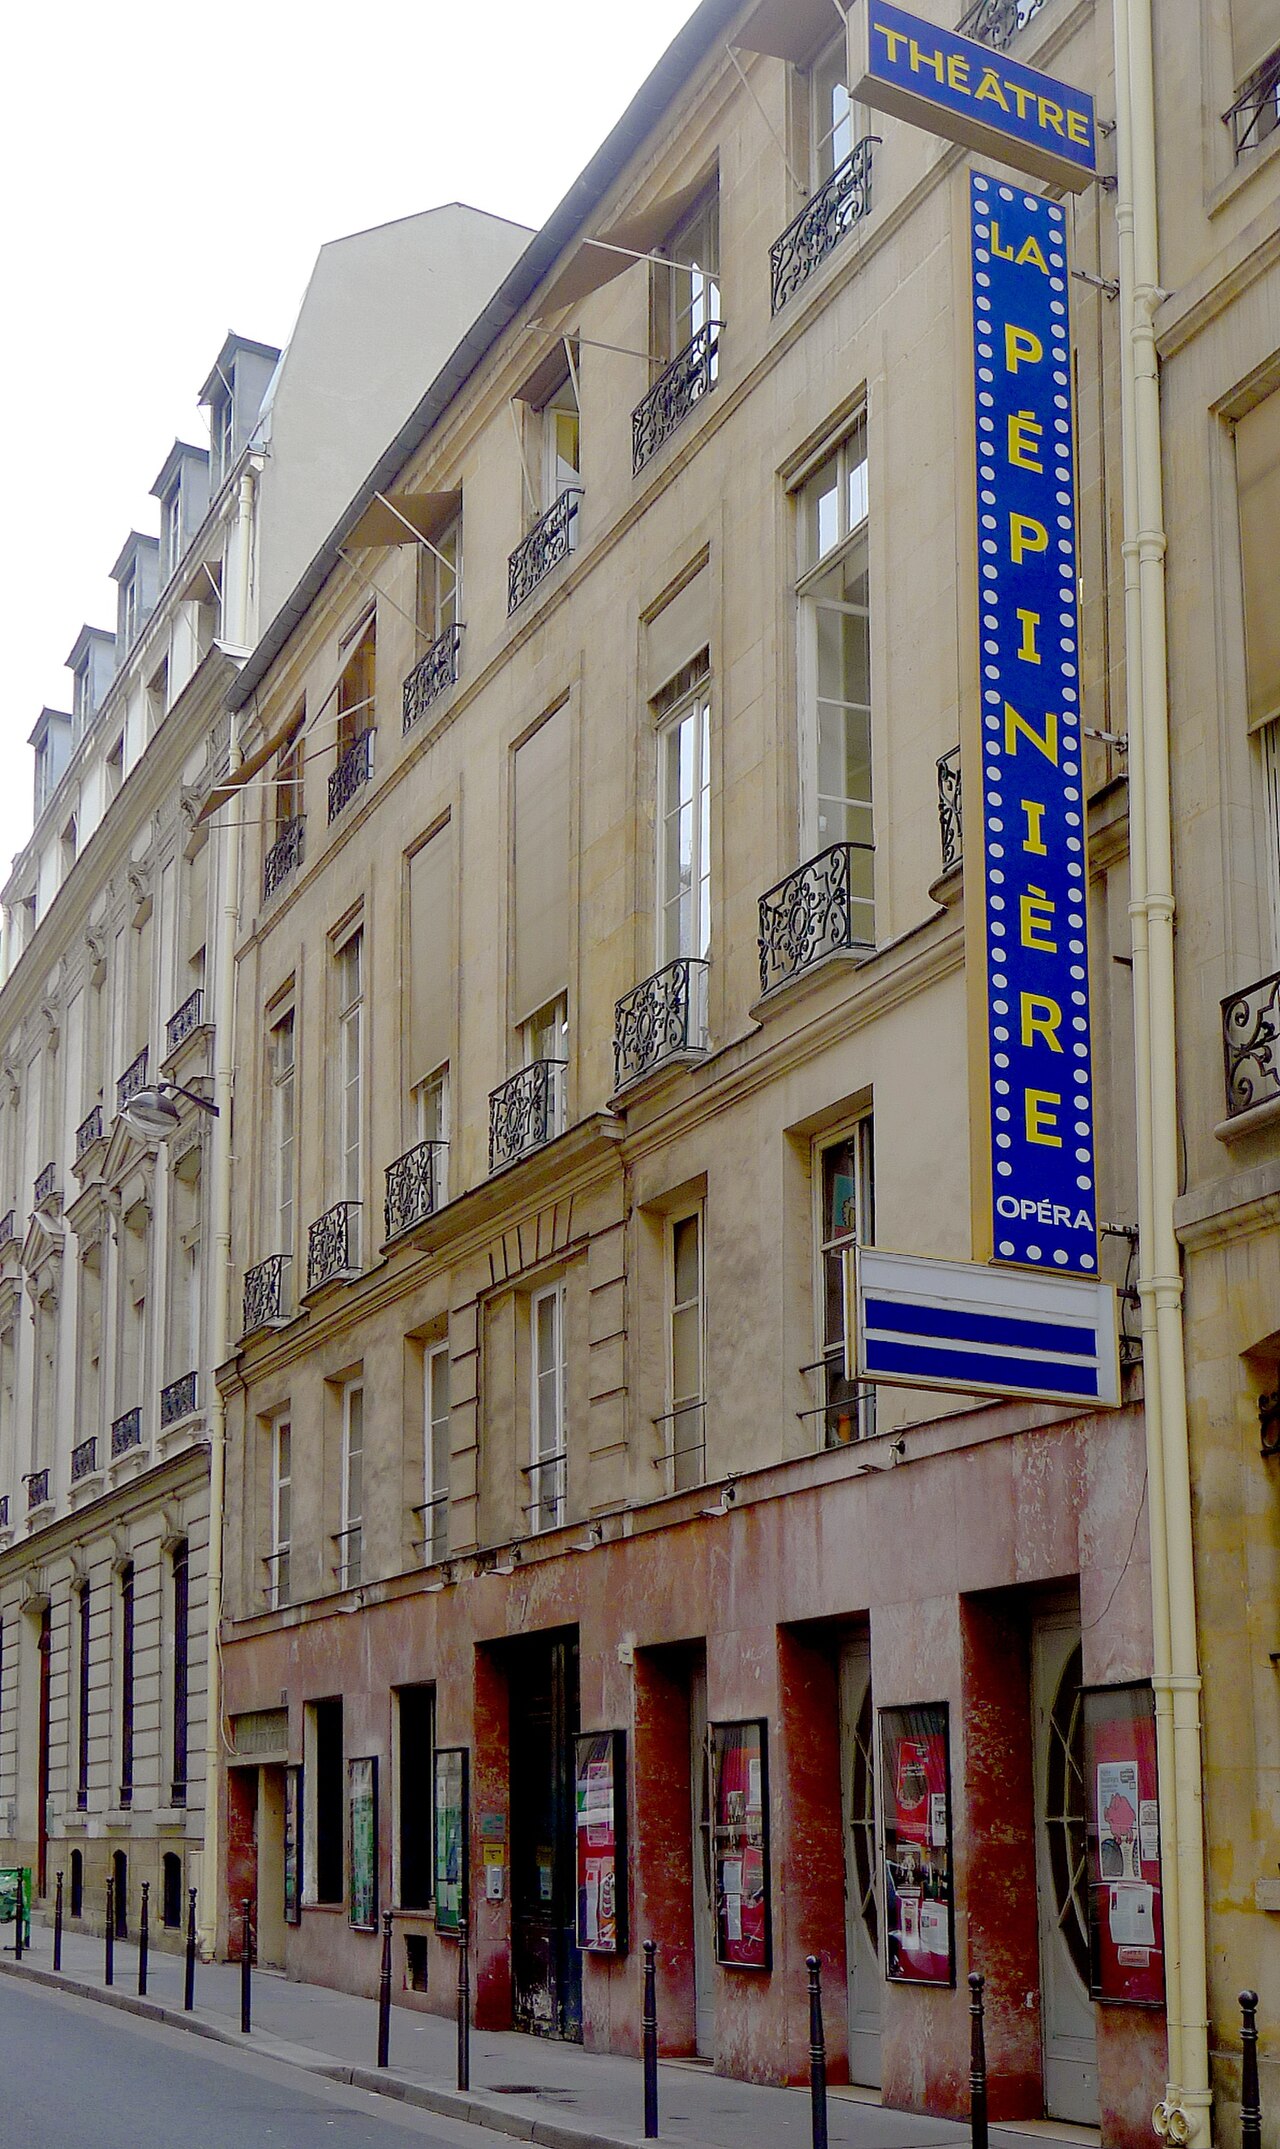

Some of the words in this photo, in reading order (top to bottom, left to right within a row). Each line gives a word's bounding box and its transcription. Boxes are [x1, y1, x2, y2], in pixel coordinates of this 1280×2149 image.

[874, 23, 1090, 148] THÉÂTRE
[990, 221, 1050, 275] LA
[1003, 323, 1064, 1148] PÉPINIÈRE
[996, 1195, 1094, 1232] OPÉRA
